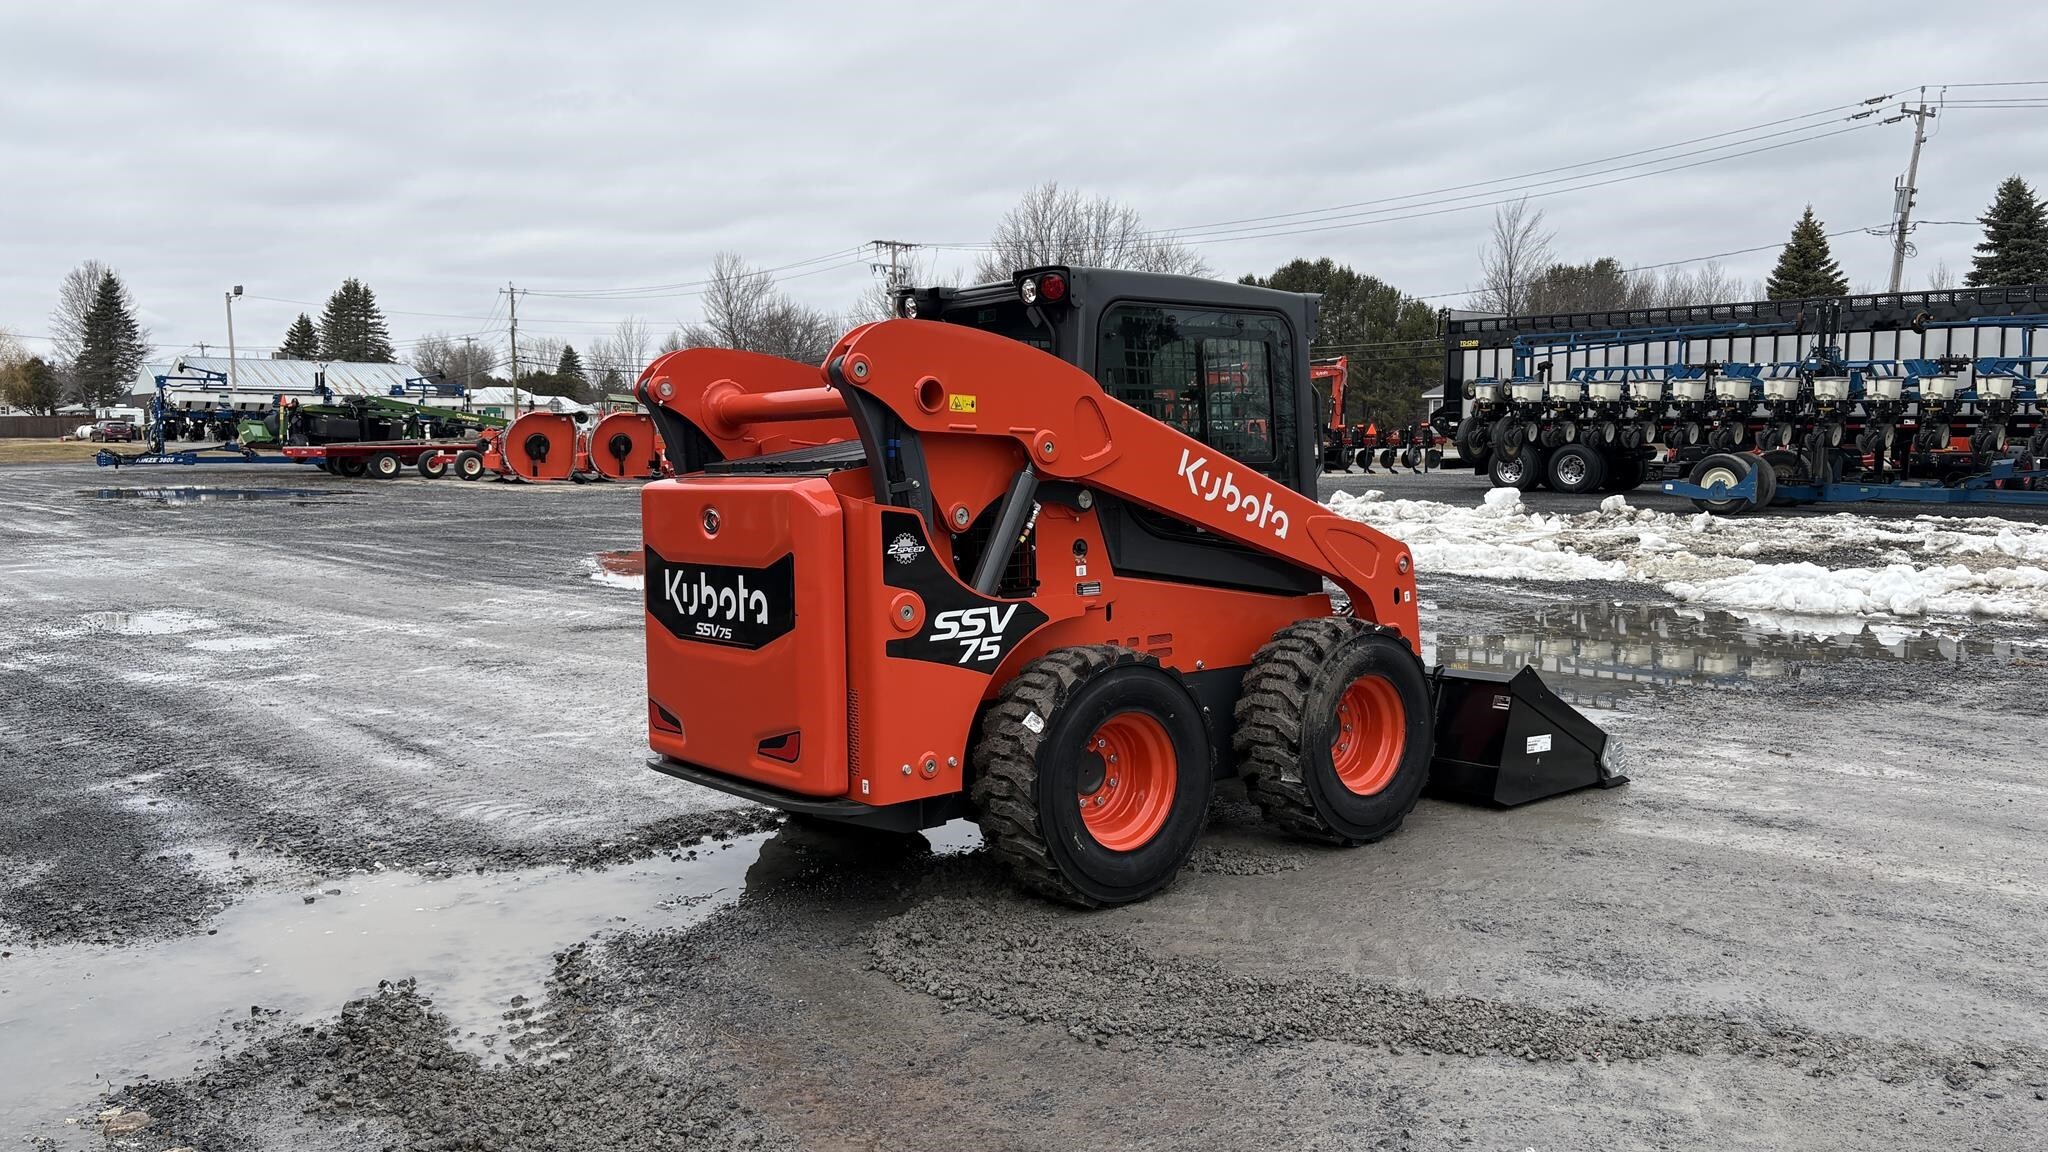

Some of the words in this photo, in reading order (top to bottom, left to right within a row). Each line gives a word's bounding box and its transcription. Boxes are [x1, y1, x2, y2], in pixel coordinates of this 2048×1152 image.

[1177, 448, 1289, 540] Kubota
[664, 568, 768, 625] Kubota
[929, 603, 1019, 642] SSV
[958, 635, 1003, 664] 75
